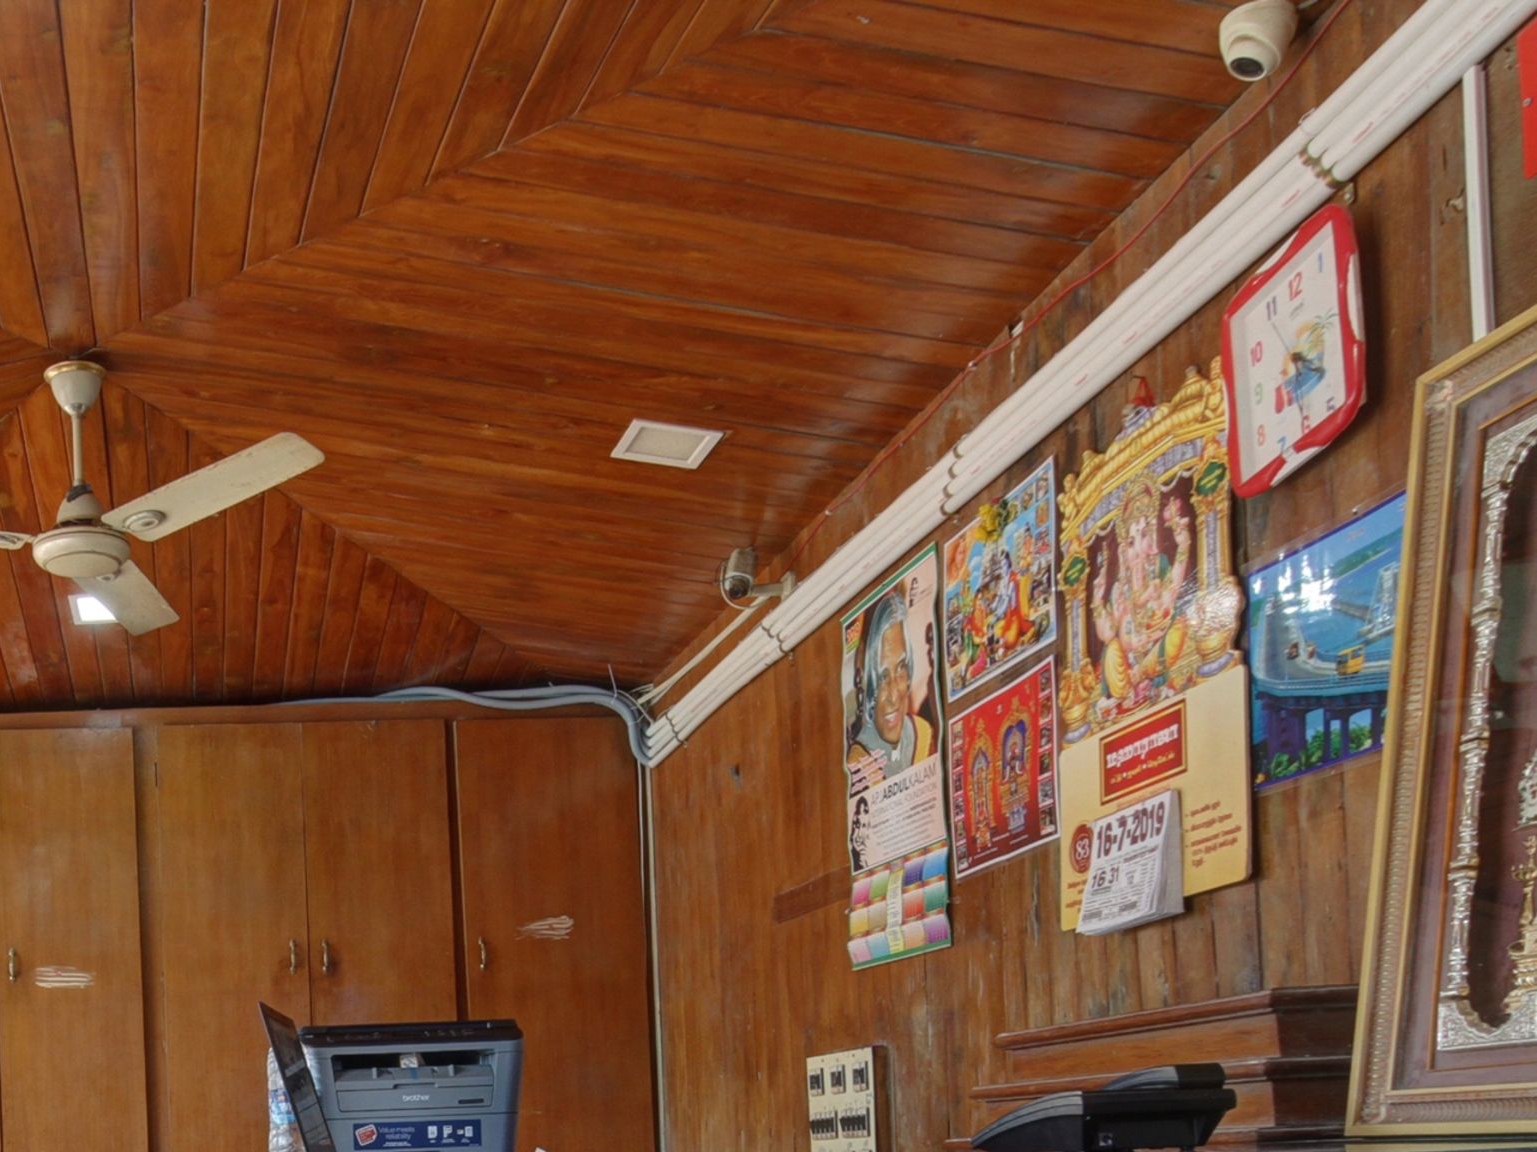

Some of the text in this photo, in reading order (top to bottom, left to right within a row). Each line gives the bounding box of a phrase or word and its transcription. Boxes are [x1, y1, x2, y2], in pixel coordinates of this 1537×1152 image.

[1288, 271, 1303, 301] 12
[1266, 295, 1277, 321] 11
[1250, 340, 1263, 367] 10
[1254, 383, 1264, 406] 9
[1257, 423, 1266, 446] 8
[1096, 801, 1166, 859] 16-7-2019
[1074, 837, 1090, 861] 83
[1091, 865, 1120, 889] 16 31
[402, 1093, 431, 1102] brother
